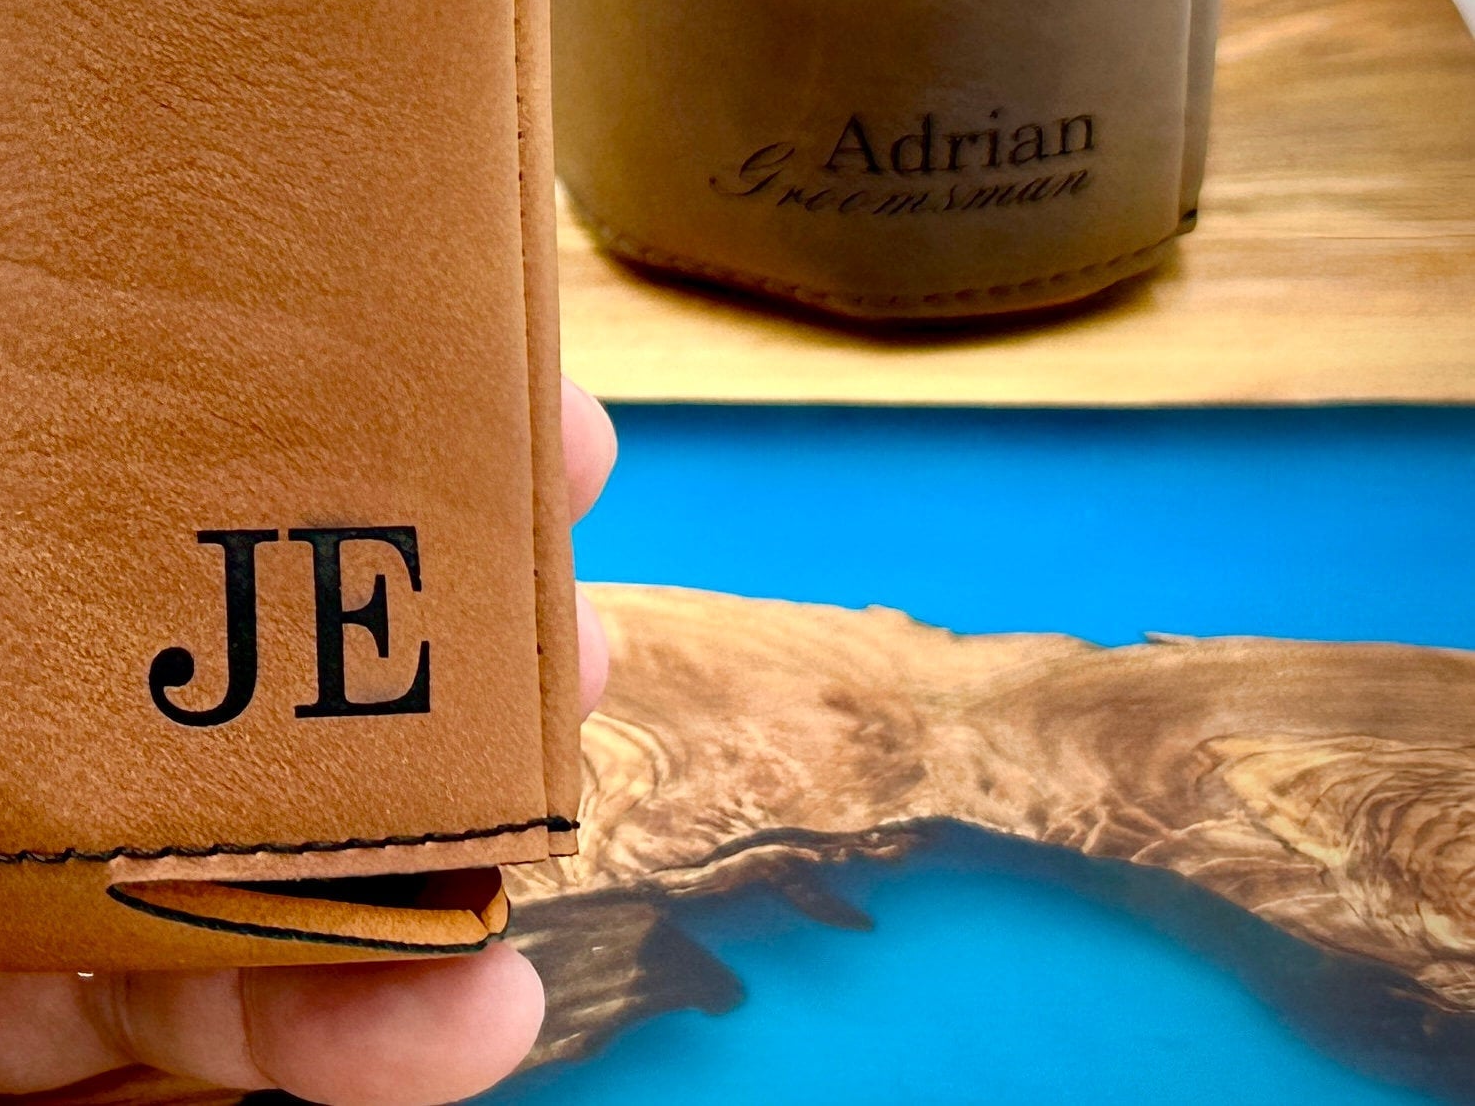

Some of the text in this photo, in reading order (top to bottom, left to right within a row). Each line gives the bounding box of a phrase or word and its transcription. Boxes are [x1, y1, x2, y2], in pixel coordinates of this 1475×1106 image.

[708, 140, 1089, 216] Groomsman
[822, 108, 1098, 177] Adrian
[148, 525, 431, 728] JE
